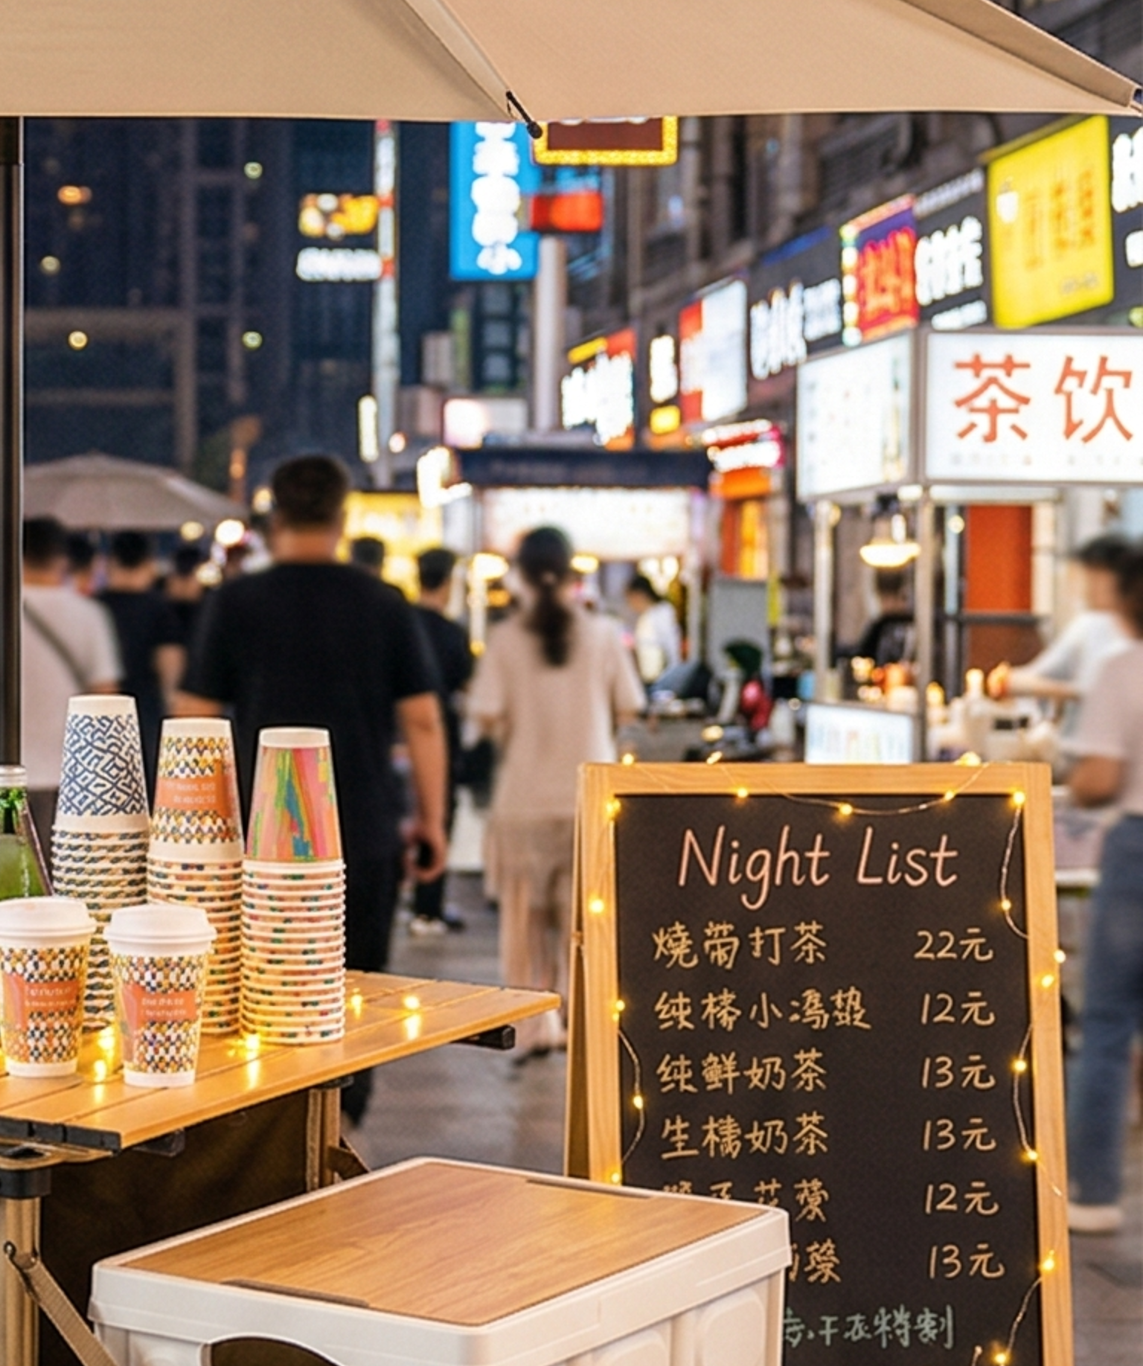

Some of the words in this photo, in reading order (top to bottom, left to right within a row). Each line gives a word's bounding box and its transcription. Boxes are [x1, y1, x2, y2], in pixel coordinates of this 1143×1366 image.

[955, 354, 1132, 443] 茶饮
[679, 825, 830, 910] Night
[857, 826, 958, 887] List
[914, 928, 993, 961] 22元
[922, 991, 995, 1025] 12元
[657, 1048, 826, 1094] 纯鲜奶茶
[922, 1055, 995, 1089] 13元
[924, 1118, 996, 1150] 13元
[926, 1182, 999, 1214] 12元
[930, 1244, 1004, 1278] 13元
